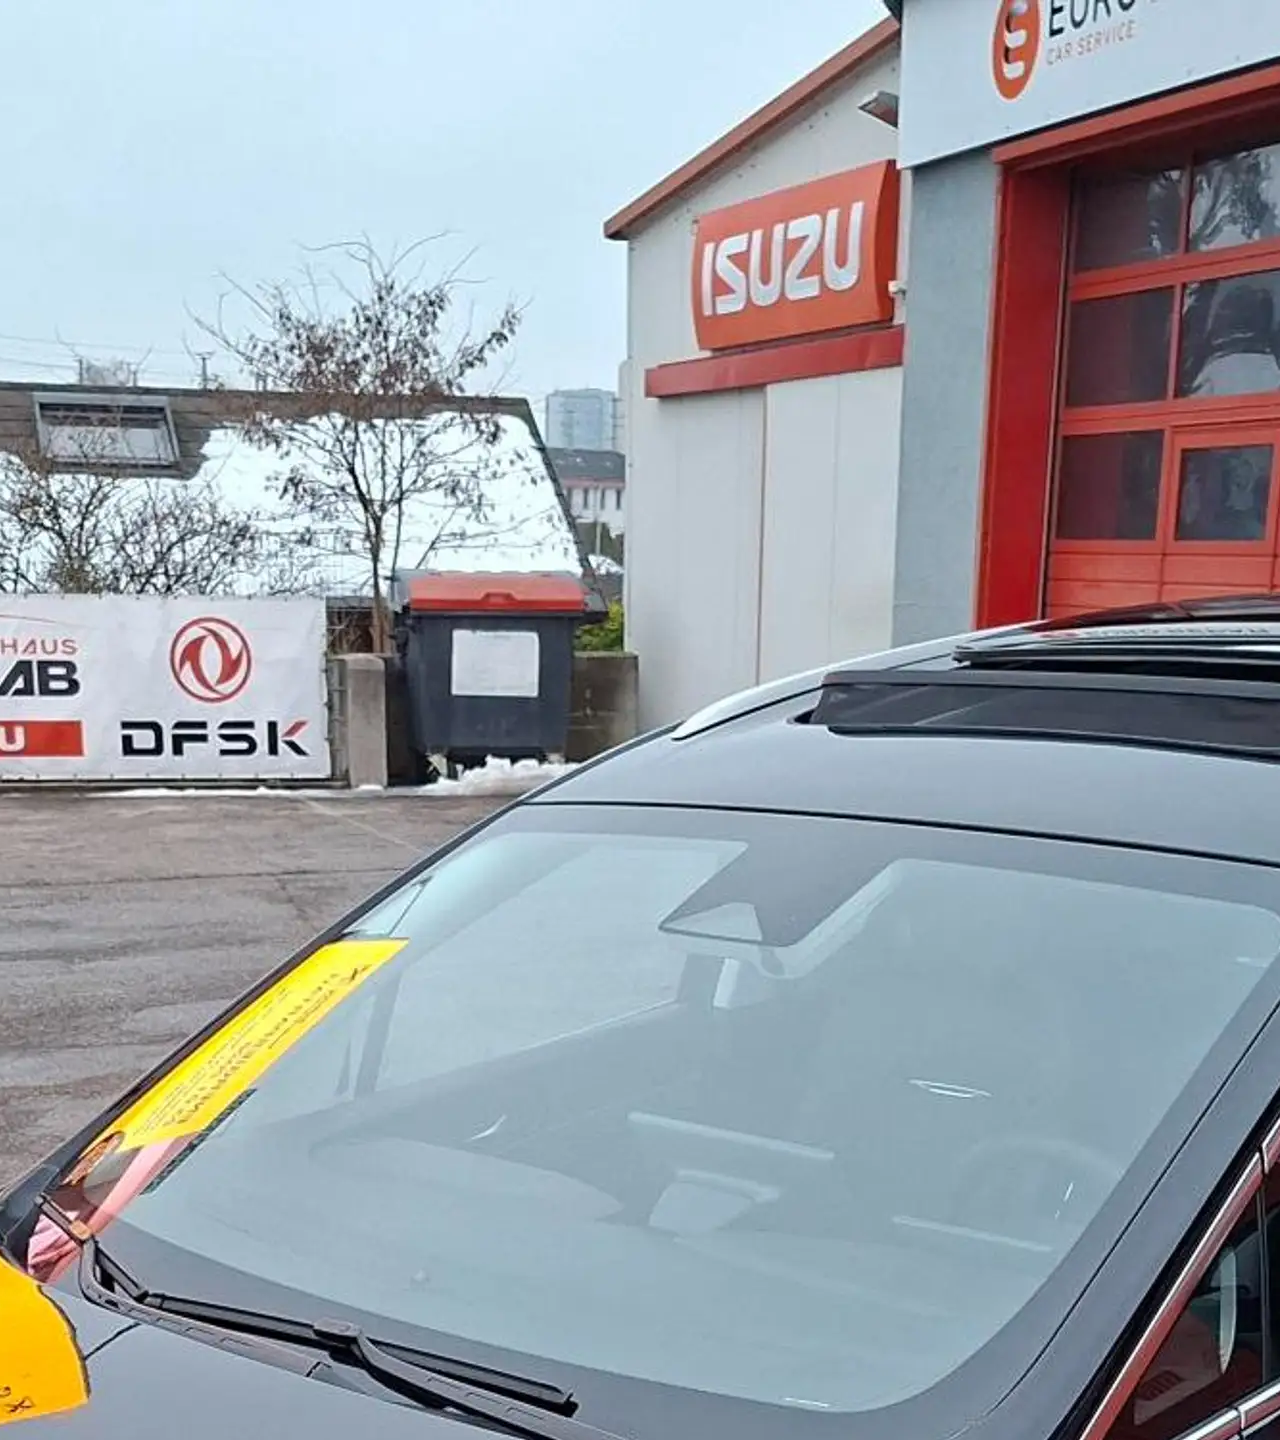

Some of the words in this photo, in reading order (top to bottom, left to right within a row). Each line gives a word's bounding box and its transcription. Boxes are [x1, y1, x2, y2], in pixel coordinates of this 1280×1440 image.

[1046, 42, 1073, 66] CAR
[1077, 19, 1137, 56] SERVICE
[701, 200, 865, 317] ISUZU
[120, 720, 310, 757] DFSK
